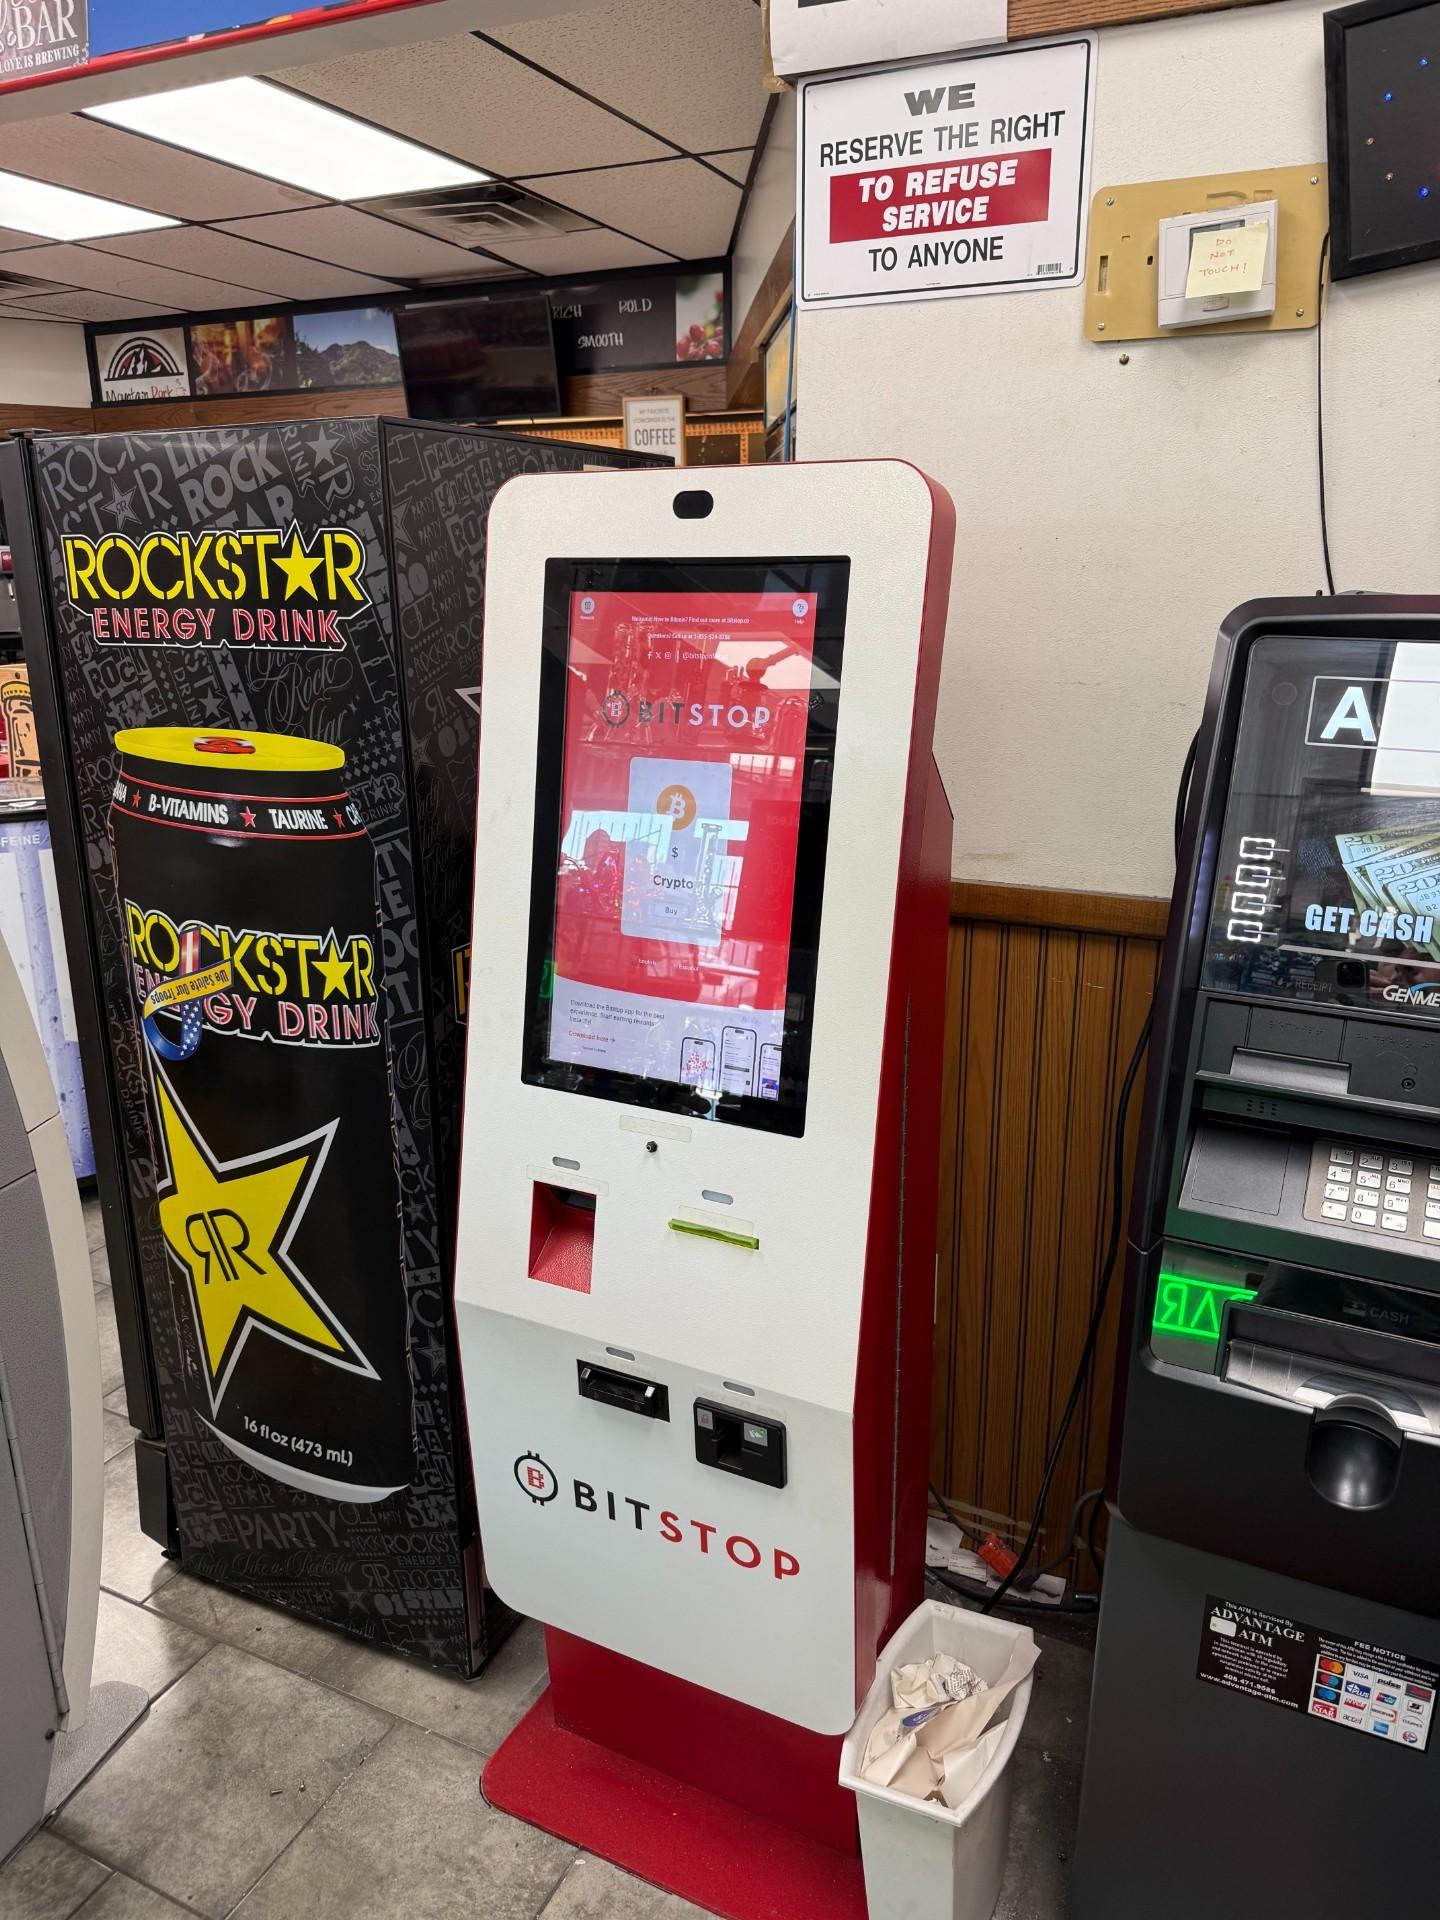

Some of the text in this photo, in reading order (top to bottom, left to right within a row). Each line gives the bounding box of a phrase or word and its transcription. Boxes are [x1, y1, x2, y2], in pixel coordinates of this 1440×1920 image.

[12, 0, 78, 50] BAR
[24, 54, 34, 68] IS
[35, 43, 80, 66] BREWING
[904, 82, 976, 117] WE
[820, 110, 1066, 167] RESERVE THE RIGHT
[858, 159, 1018, 202] TO REFUSE
[882, 196, 990, 232] SERVICE
[869, 236, 1004, 272] TO ANYONE
[1209, 249, 1235, 260] NOT
[1215, 238, 1232, 246] DO
[1200, 262, 1247, 276] TOUCH!
[553, 298, 652, 320] RICH BOLD
[577, 332, 624, 349] SMOOTH
[634, 428, 676, 446] COFFEE
[178, 432, 283, 526] ROCK
[93, 607, 341, 643] ENERGY DRINK
[638, 700, 770, 730] BITSTOP
[148, 793, 229, 825] B-VITAMINS
[268, 808, 328, 831] TAURINE
[653, 874, 694, 890] Crypto
[1374, 863, 1416, 881] 20
[1397, 876, 1438, 896] 20
[665, 906, 678, 915] Buy
[1305, 904, 1434, 943] GET CASH
[150, 969, 229, 1005] We Salute Our Troops
[278, 1001, 377, 1039] DRINK
[1370, 1307, 1410, 1324] CASH
[244, 1416, 258, 1433] 16
[271, 1431, 289, 1447] oz
[291, 1436, 323, 1458] (473
[326, 1449, 353, 1467] mL)
[573, 1478, 801, 1580] BITSTOP
[1211, 1606, 1305, 1642] ADVANTAGE
[1225, 1601, 1237, 1610] This
[1238, 1606, 1252, 1614] ATM
[1258, 1610, 1284, 1624] Serviced
[1285, 1619, 1294, 1627] By
[1238, 1629, 1273, 1647] ATM
[1354, 1640, 1406, 1661] FEE NOTICE
[1352, 1670, 1370, 1680] VISA
[1200, 1672, 1298, 1708] www.advantage-atm.com
[1352, 1688, 1370, 1698] PLUS
[1313, 1704, 1335, 1718] STAR
